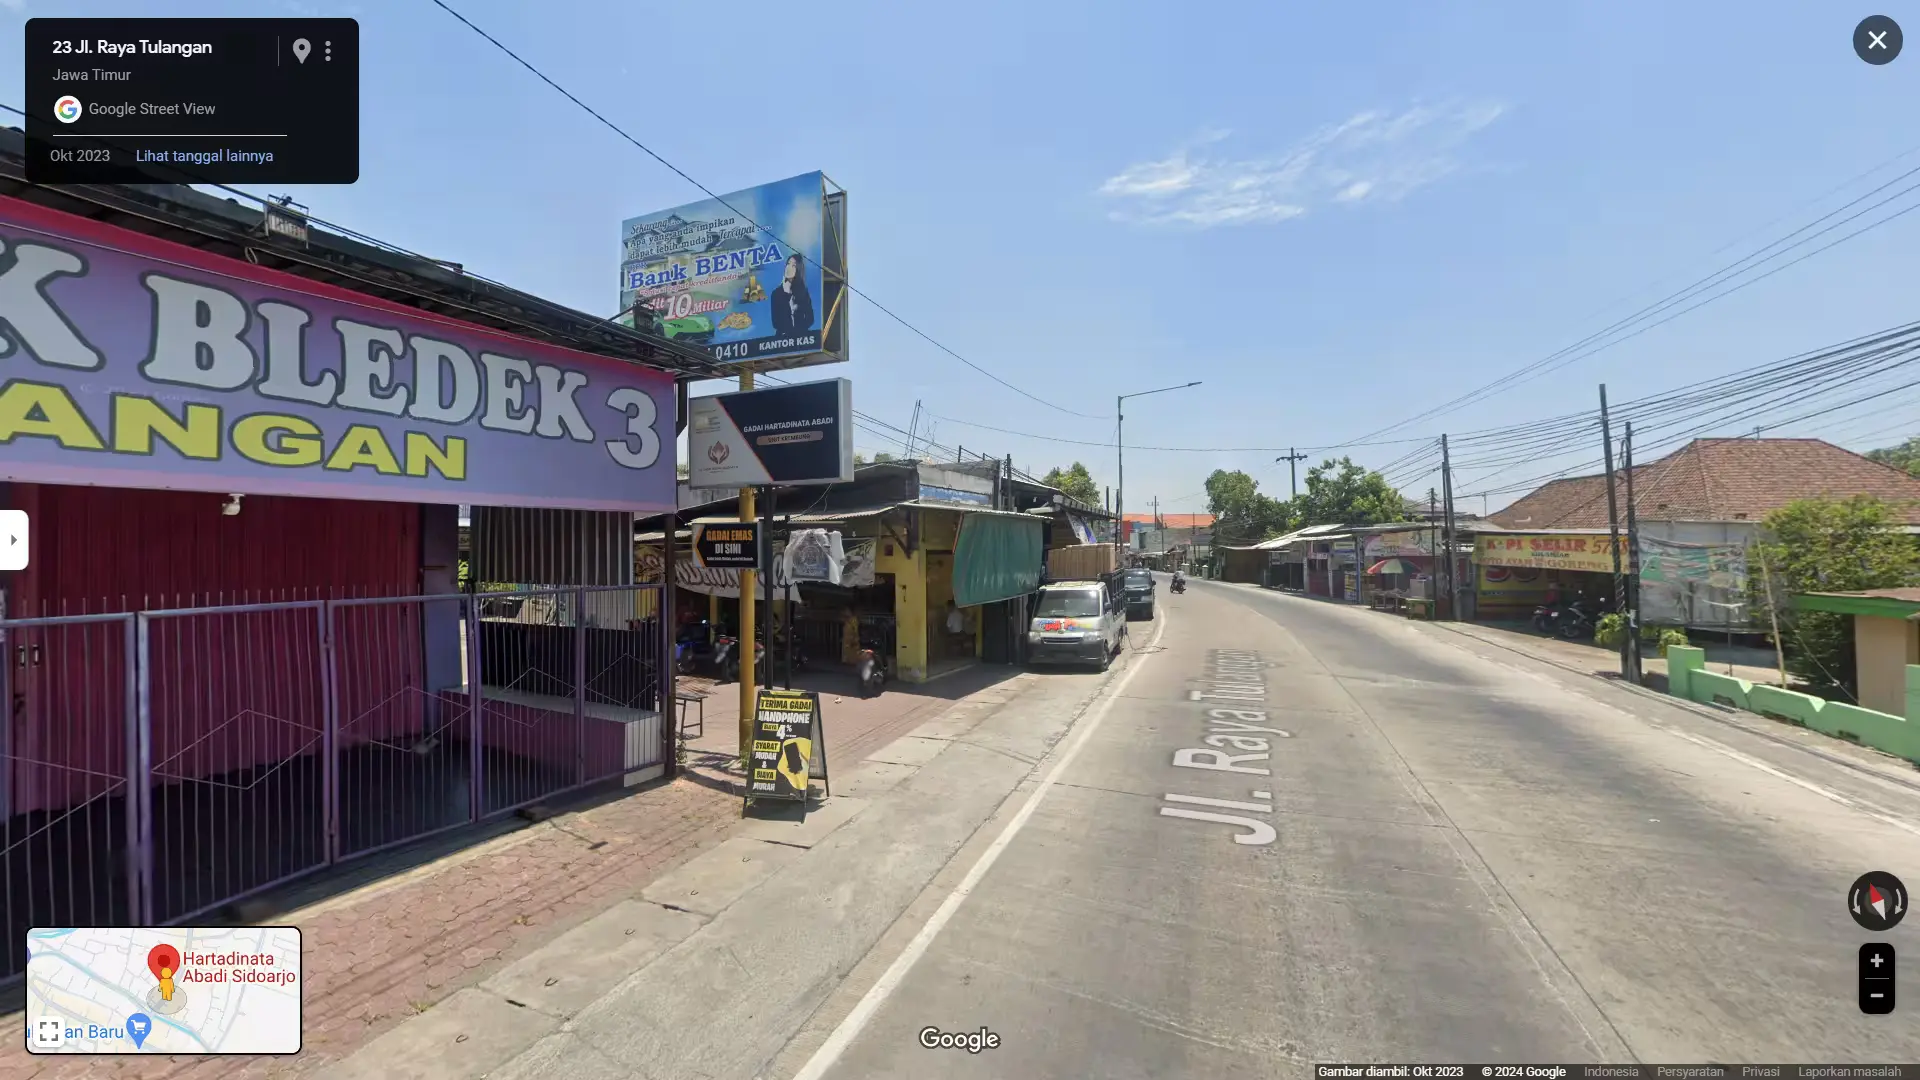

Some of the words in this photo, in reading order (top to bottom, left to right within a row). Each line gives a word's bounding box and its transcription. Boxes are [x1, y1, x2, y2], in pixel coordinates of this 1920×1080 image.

[630, 238, 646, 249] Apa
[697, 217, 735, 232] impikan
[630, 250, 654, 261] dapat
[656, 242, 679, 255] lebih
[681, 234, 713, 249] mudah
[629, 263, 687, 290] Bank
[695, 242, 783, 277] BENTA
[664, 294, 692, 320] 10
[691, 300, 728, 315] Miliar
[759, 339, 794, 351] KANTOR
[796, 336, 815, 346] KAS
[715, 343, 748, 361] 0410
[138, 270, 595, 443] BLEDEK
[605, 387, 661, 470] 3
[743, 424, 763, 433] GADAI
[764, 419, 810, 431] HARTADINATA
[811, 417, 833, 426] ABADI
[706, 529, 730, 541] GADAI
[731, 529, 753, 541] EMAS
[715, 543, 724, 554] DI
[725, 543, 742, 554] SINI
[761, 700, 788, 709] TERIMA
[789, 701, 811, 710] GADAI
[758, 711, 810, 724] HANDPHONE
[755, 742, 778, 751] SYARAT
[755, 752, 777, 760] MUDAH
[756, 771, 774, 779] BIAYA
[752, 783, 775, 791] MURAH
